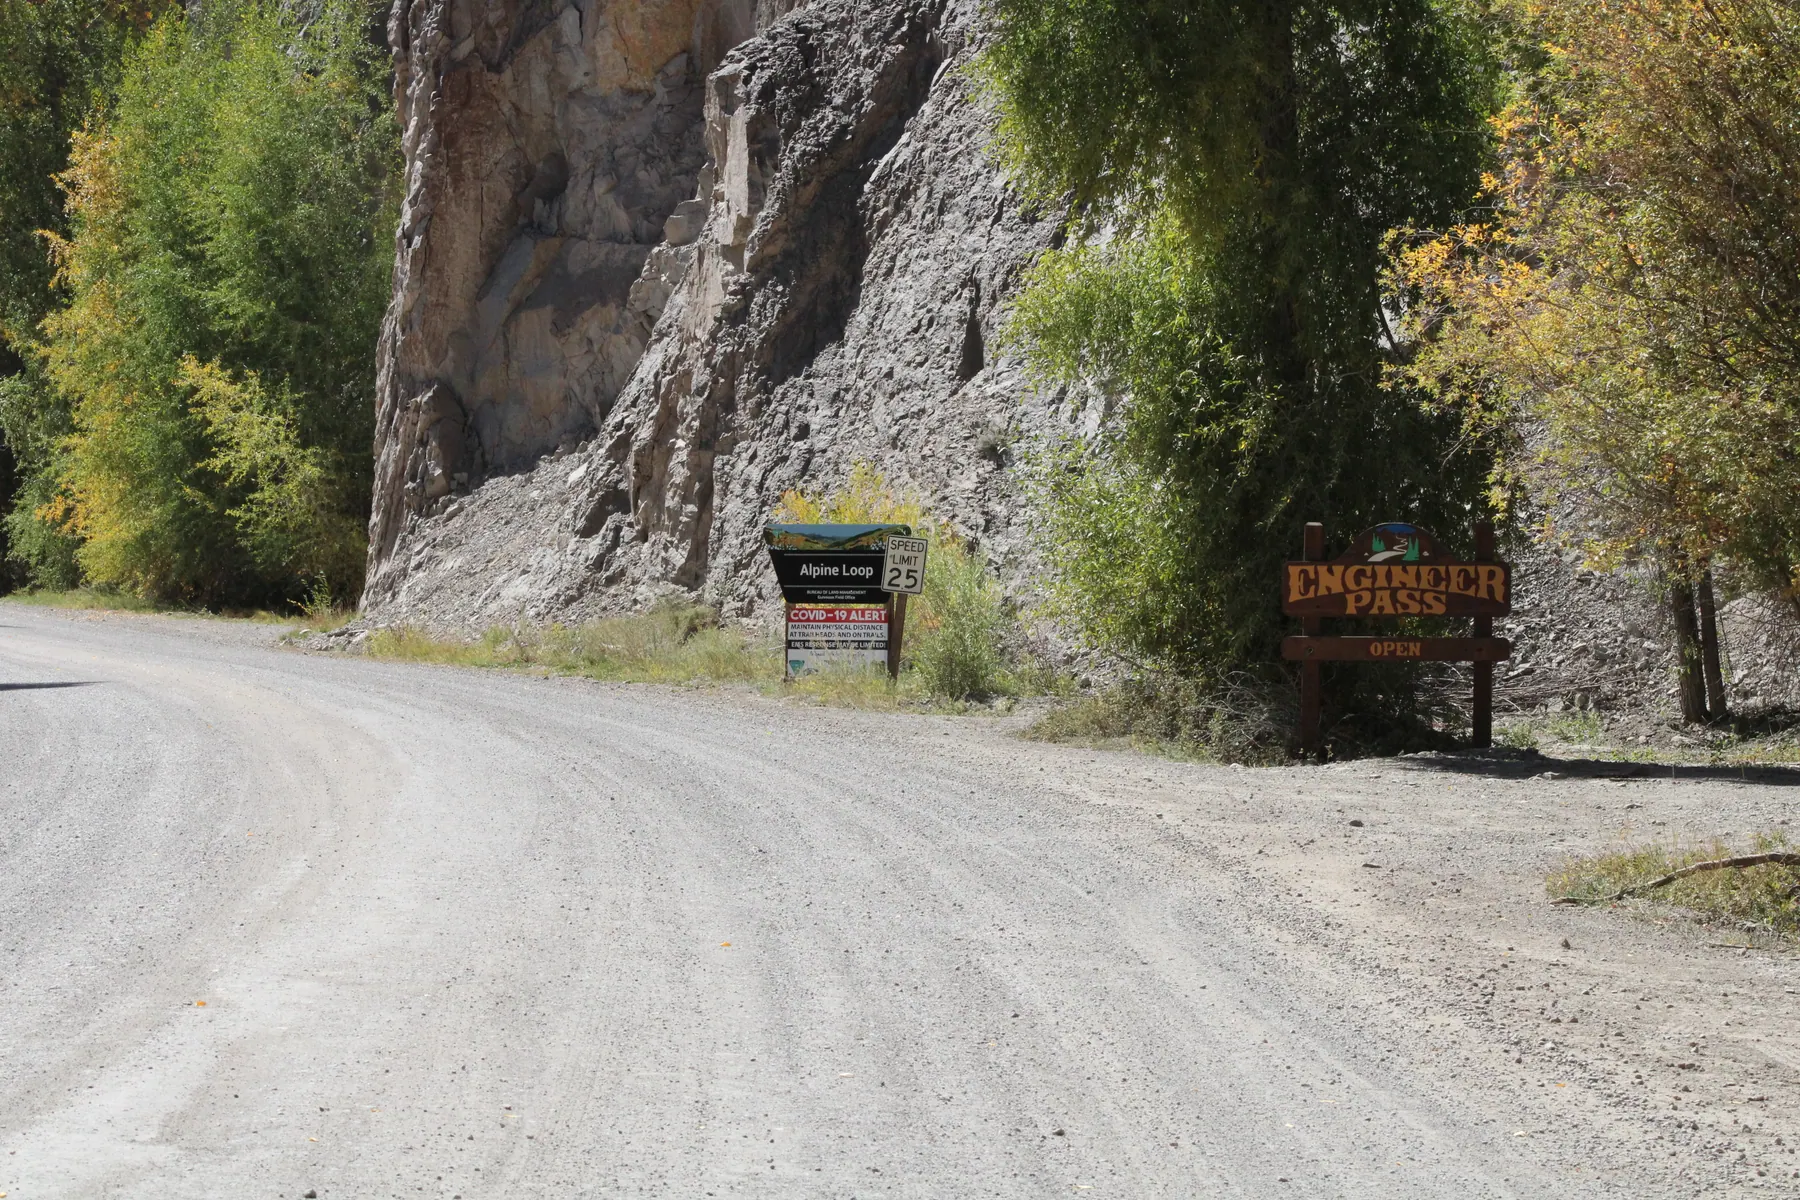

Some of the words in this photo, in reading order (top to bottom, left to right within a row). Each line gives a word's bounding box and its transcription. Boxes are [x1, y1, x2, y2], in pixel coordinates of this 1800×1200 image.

[890, 539, 925, 552] SPEED
[892, 554, 918, 566] LIMIT
[800, 563, 839, 579] Alpine
[842, 564, 874, 579] Loop
[887, 567, 918, 589] 25
[1287, 565, 1505, 603] ENGINEER
[1345, 589, 1447, 615] PASS
[790, 610, 847, 620] COVID-19
[850, 610, 887, 621] ALERT
[1369, 641, 1422, 657] OPEN
